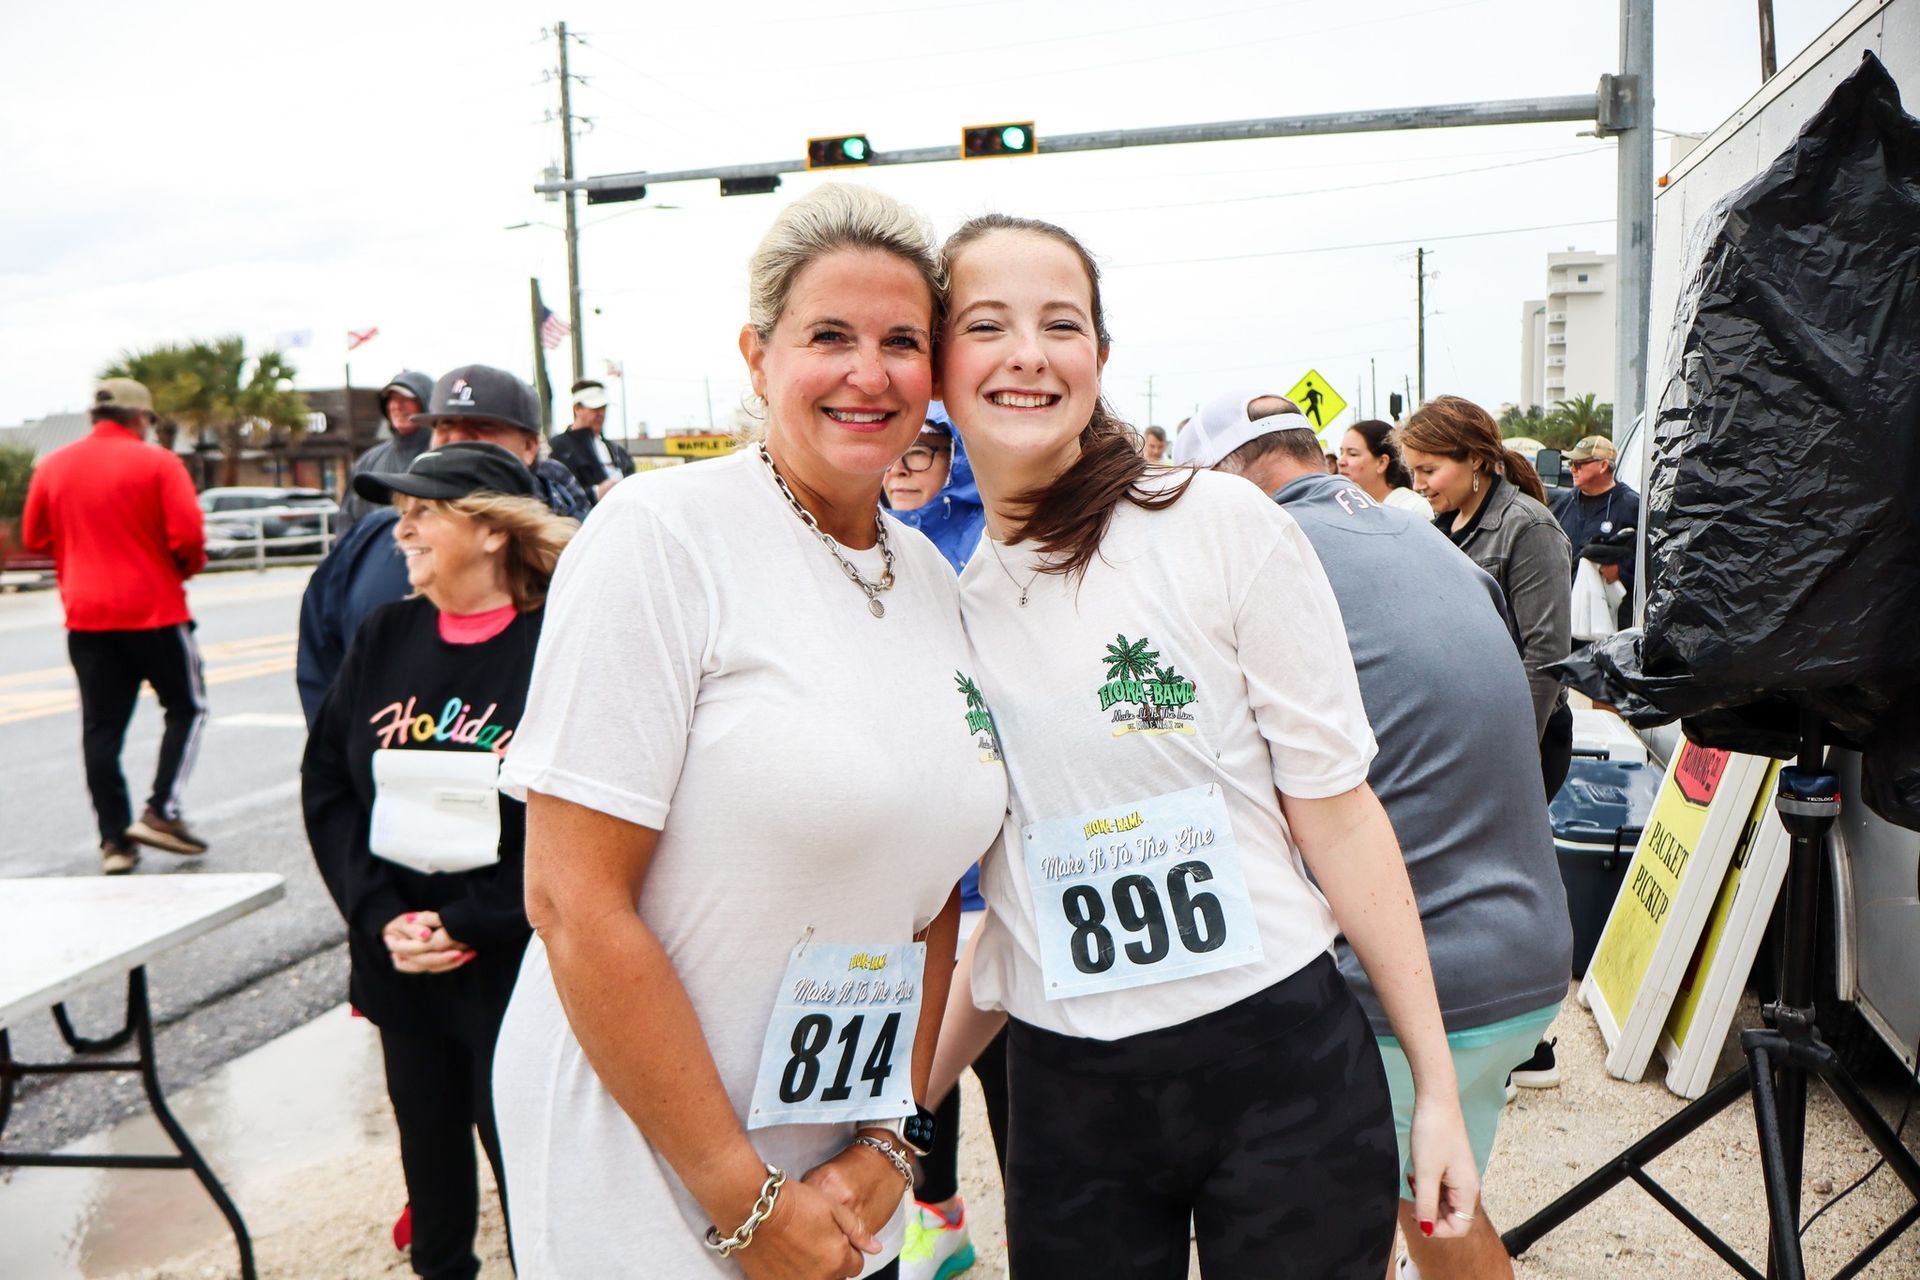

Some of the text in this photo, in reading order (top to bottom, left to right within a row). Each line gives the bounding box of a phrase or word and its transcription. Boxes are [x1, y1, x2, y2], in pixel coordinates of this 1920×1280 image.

[677, 440, 720, 450] WAFFLE
[1040, 825, 1214, 881] Make It To The Line
[1649, 821, 1689, 880] PACKET
[1062, 860, 1227, 974] 896
[1631, 864, 1668, 924] PICKUP
[793, 977, 914, 1005] Make It To The Line
[779, 1012, 901, 1104] 814
